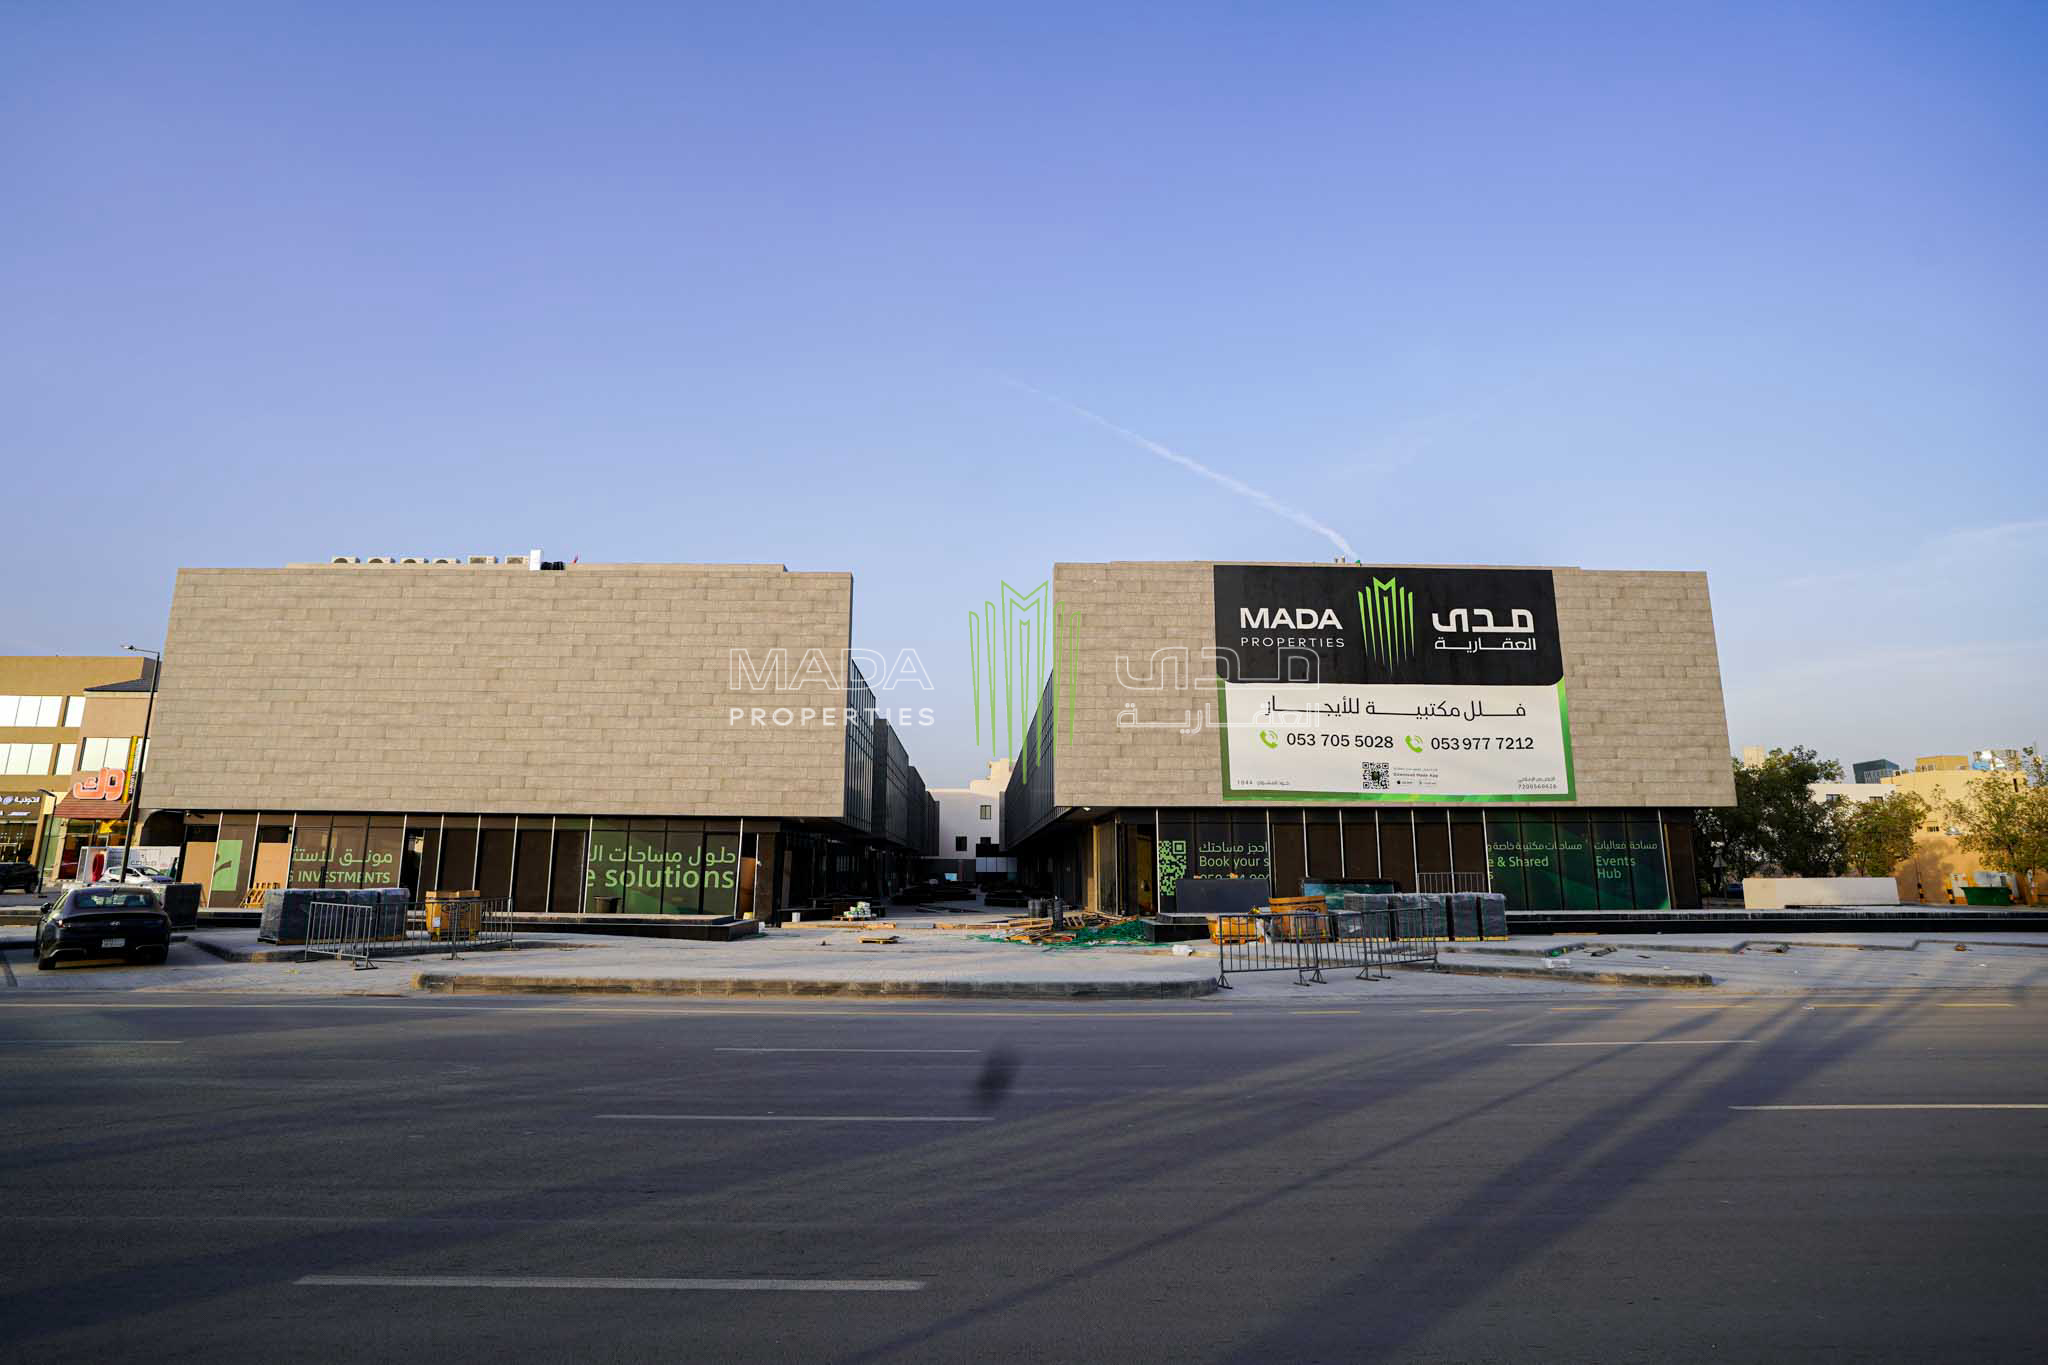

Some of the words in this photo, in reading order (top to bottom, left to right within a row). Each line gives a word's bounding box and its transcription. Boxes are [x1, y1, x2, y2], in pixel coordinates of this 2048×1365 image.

[1240, 607, 1343, 630] MADA
[1432, 607, 1535, 633] مدى
[1241, 637, 1345, 648] PROPERTIES
[1434, 636, 1537, 654] العقارية
[1365, 700, 1461, 720] مكتبية
[1286, 732, 1316, 747] 053
[1321, 733, 1350, 747] 705
[1354, 735, 1394, 749] 5028
[1431, 737, 1460, 750] 053
[1464, 737, 1490, 750] 977
[1496, 737, 1534, 750] 7212
[609, 846, 683, 863] مساحات
[1497, 857, 1506, 867] &
[1508, 856, 1549, 867] Shared
[1596, 856, 1636, 866] Events
[1200, 856, 1230, 867] Book
[1233, 858, 1260, 871] your
[605, 864, 735, 888] solutions
[1597, 868, 1622, 879] Hub
